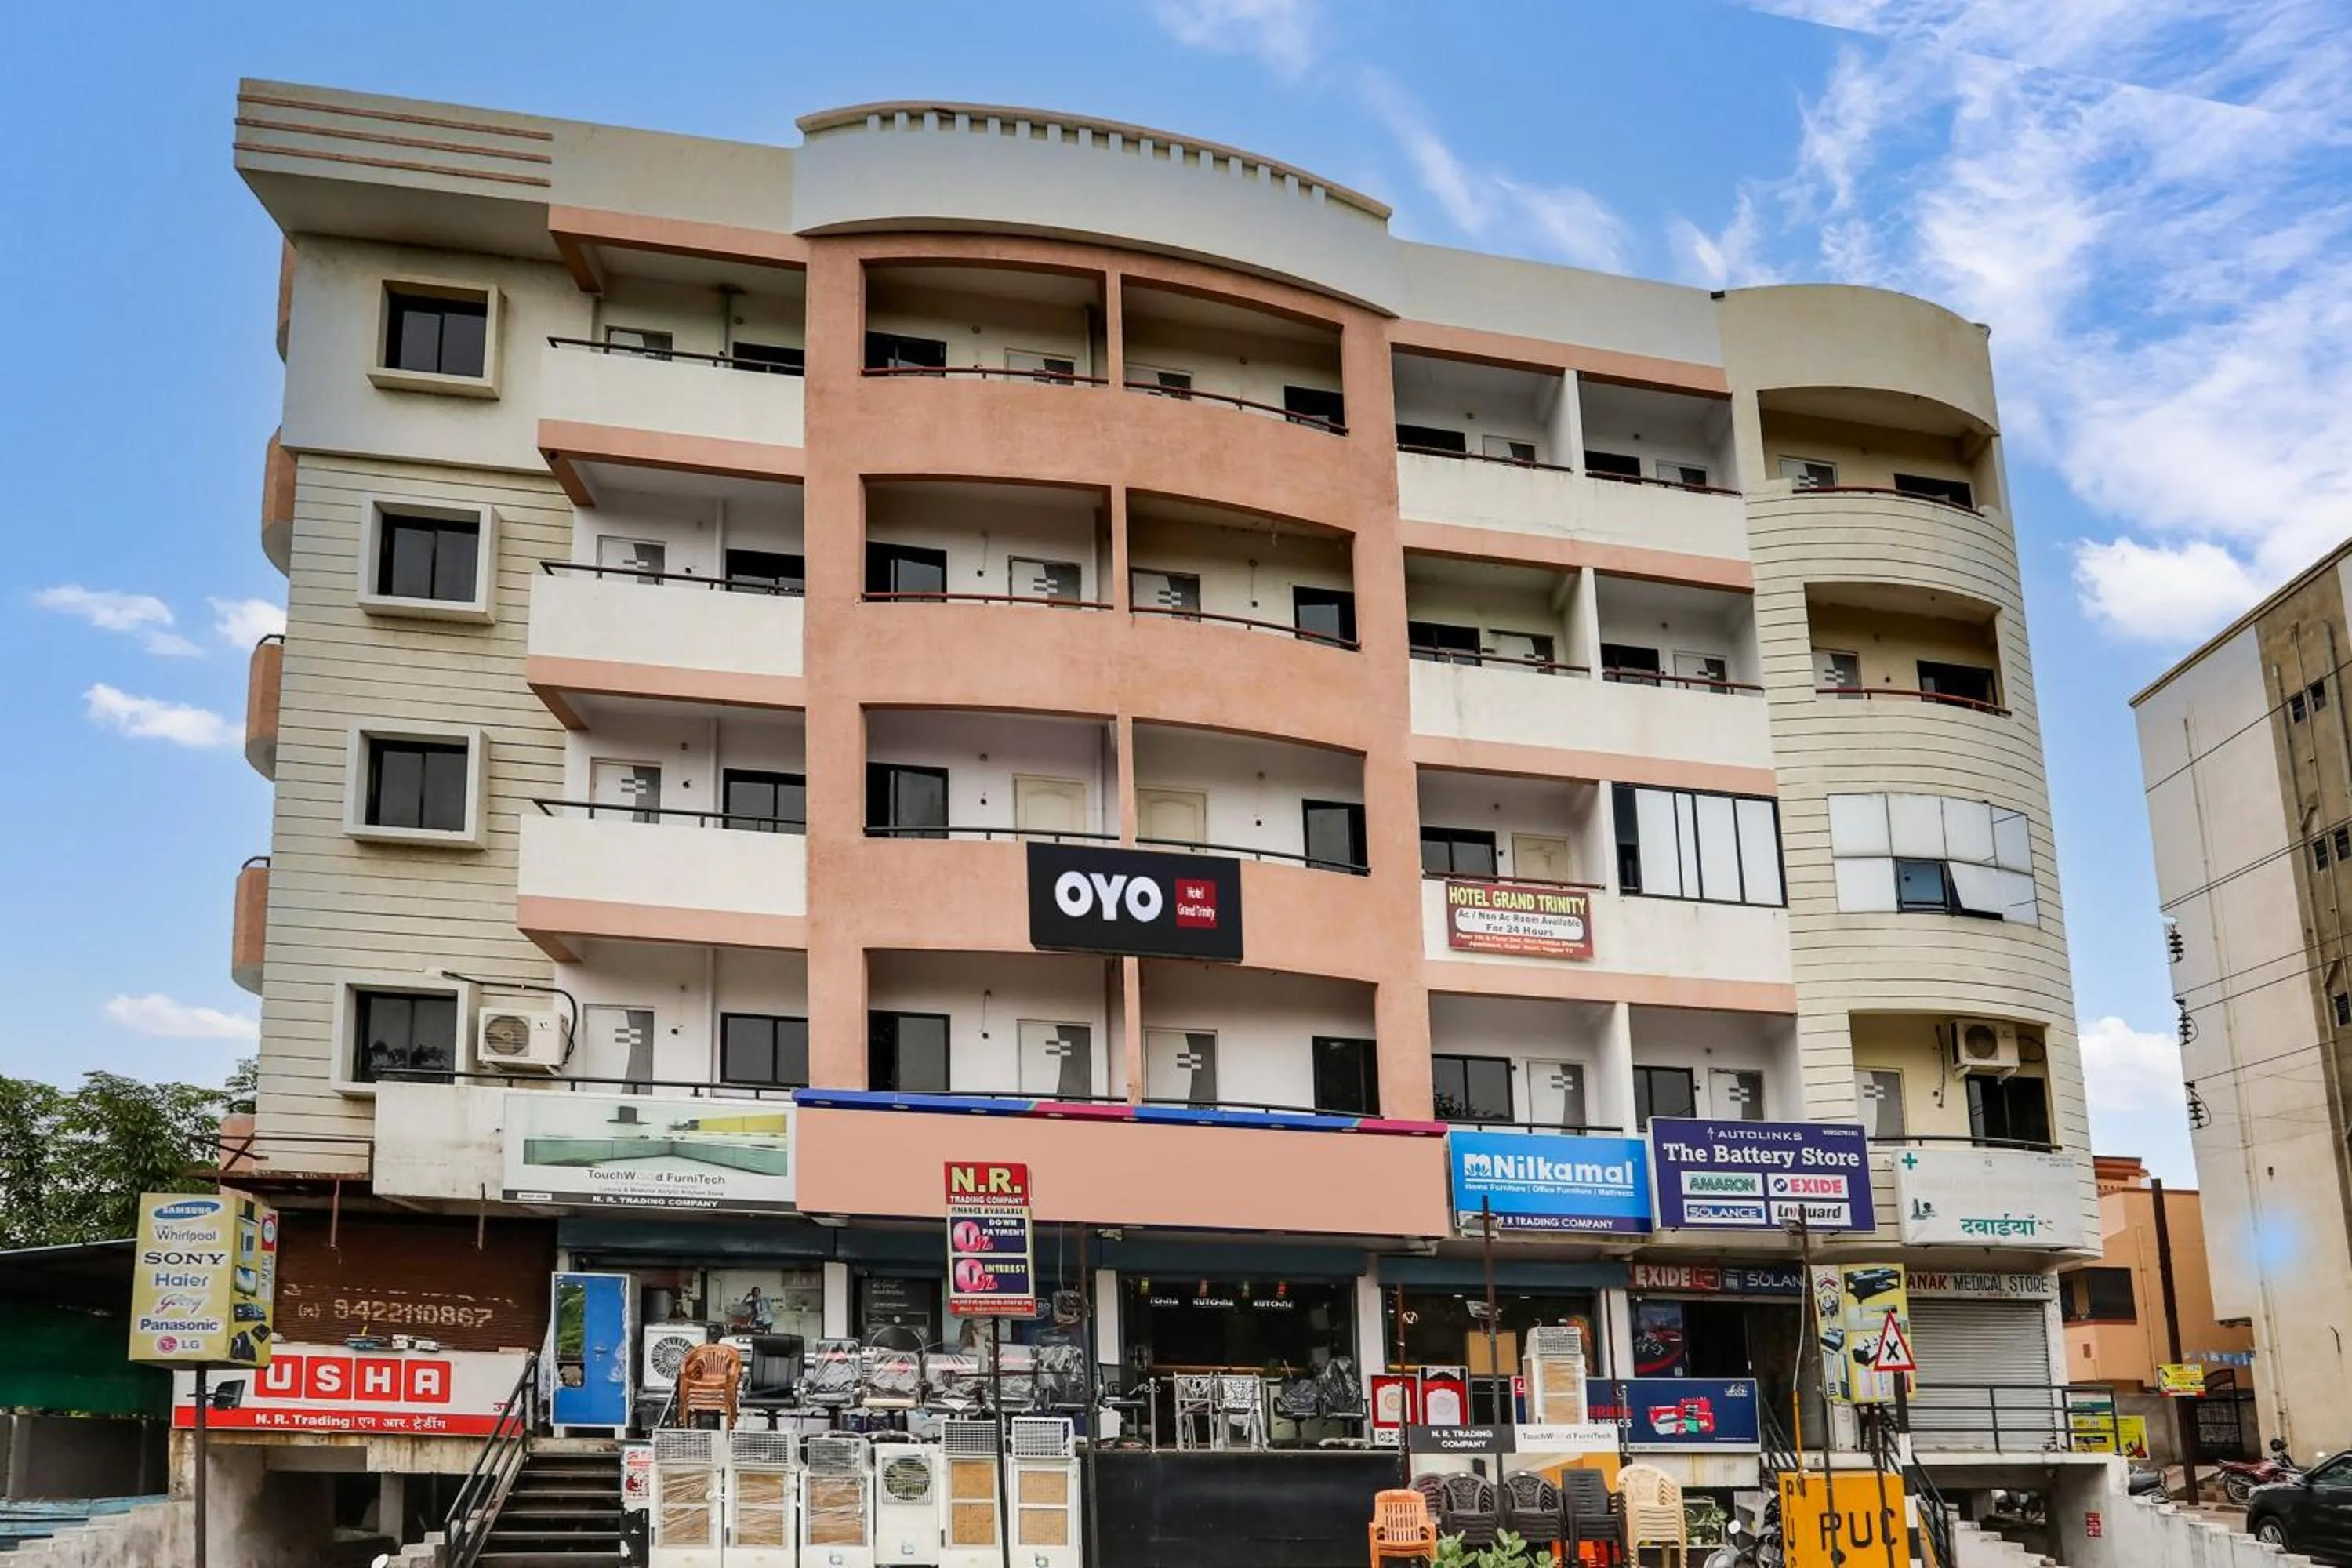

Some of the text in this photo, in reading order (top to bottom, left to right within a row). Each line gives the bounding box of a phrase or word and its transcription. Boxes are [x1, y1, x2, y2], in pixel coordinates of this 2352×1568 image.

[1055, 871, 1163, 922] OYO
[1187, 887, 1204, 899] Hotel
[1450, 886, 1585, 915] HOTEL GRAND TRINITY
[1178, 902, 1196, 916] Grand
[1507, 924, 1519, 933] 24
[1523, 927, 1554, 937] Hours
[1717, 1130, 1802, 1141] AUTOLINKS
[1663, 1142, 1860, 1168] The Battery Store
[1494, 1154, 1634, 1185] Nilkamal
[588, 1169, 725, 1185] TouchWd FurniTech
[951, 1166, 1022, 1194] N.R.
[1690, 1178, 1756, 1192] AMARON
[1790, 1178, 1842, 1194] EXIDE
[620, 1196, 666, 1206] TRADING
[668, 1198, 719, 1208] COMPANY
[162, 1206, 213, 1214] SAMSUNG
[1688, 1207, 1759, 1218] SOLANCE
[1777, 1204, 1842, 1219] Livuard
[1515, 1216, 1559, 1227] TRADING
[1562, 1218, 1613, 1229] COMPANY
[156, 1228, 216, 1242] Whirlpool
[982, 1229, 1025, 1237] PAYMENT
[144, 1252, 226, 1265] SONY
[985, 1263, 1026, 1274] INTEREST
[154, 1272, 209, 1287] Haier
[1635, 1265, 1691, 1288] EXIDE
[1907, 1274, 2049, 1292] ANAK MEDICAL STORE
[333, 1299, 494, 1328] 9422110867
[140, 1318, 219, 1331] Panasonic
[181, 1339, 200, 1349] LG
[265, 1363, 441, 1396] USHA
[255, 1414, 350, 1430] N. R. Trading
[1453, 1430, 1494, 1439] TRADING
[1441, 1439, 1487, 1449] COMPANY
[1819, 1507, 1897, 1552] PUC
